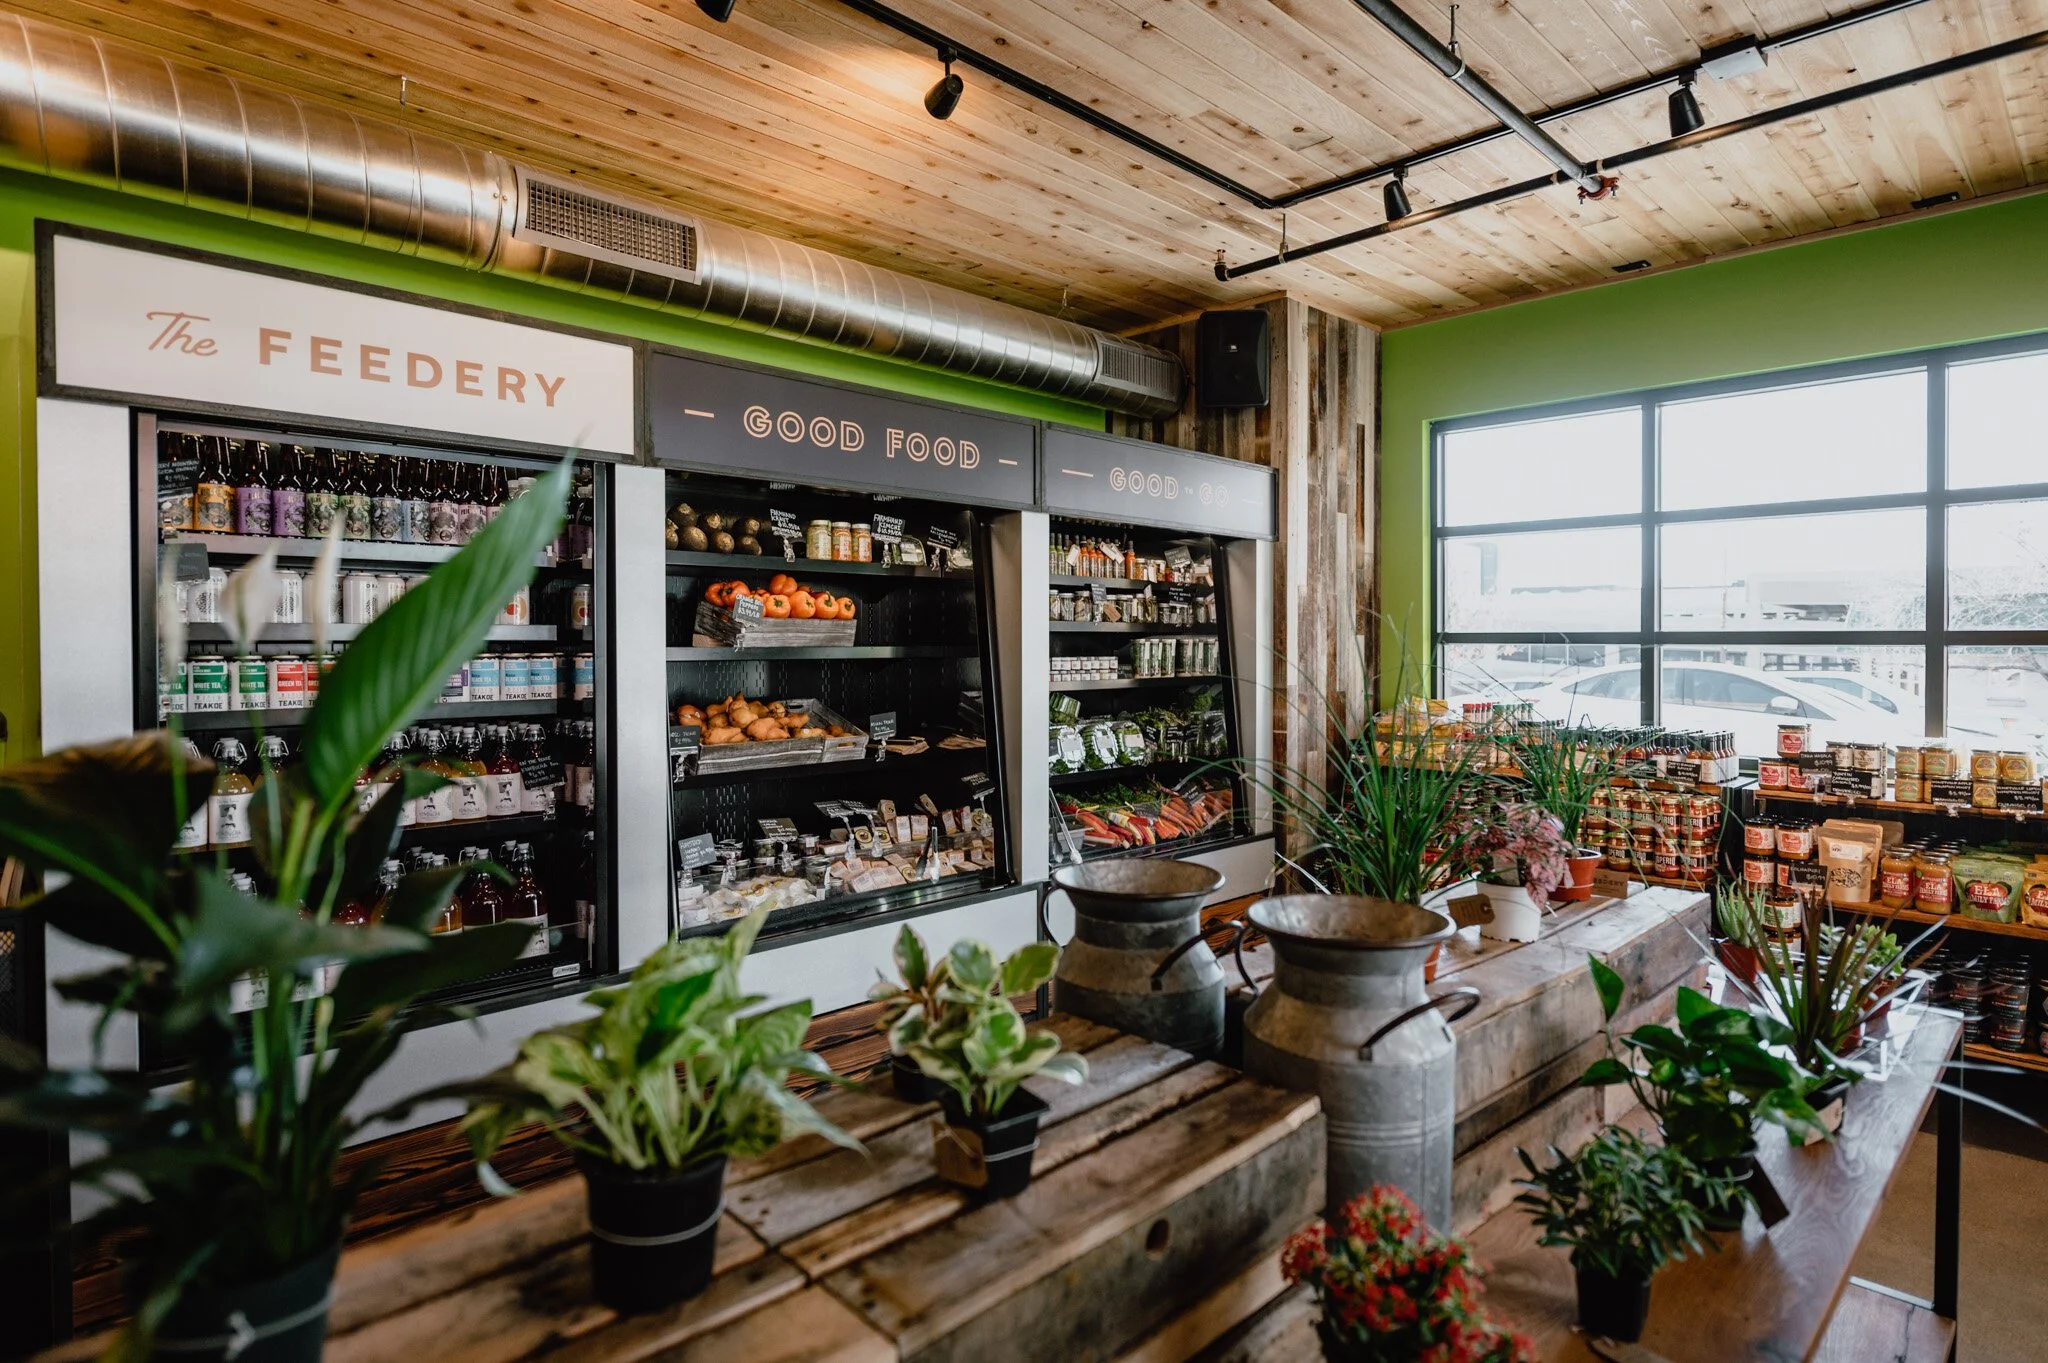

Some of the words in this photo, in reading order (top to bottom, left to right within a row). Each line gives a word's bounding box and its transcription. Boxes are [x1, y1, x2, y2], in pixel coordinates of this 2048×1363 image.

[147, 311, 219, 356] The
[258, 327, 567, 408] FEEDERY
[743, 405, 865, 452] GOOD
[886, 428, 981, 470] FOOD
[1110, 467, 1179, 499] GOOD
[1200, 482, 1230, 507] GO
[873, 513, 903, 525] FARMHAND
[879, 522, 901, 531] KIMCHI
[1887, 876, 1903, 885] ELA
[1925, 882, 1943, 890] ELA
[1974, 885, 2001, 896] ELA
